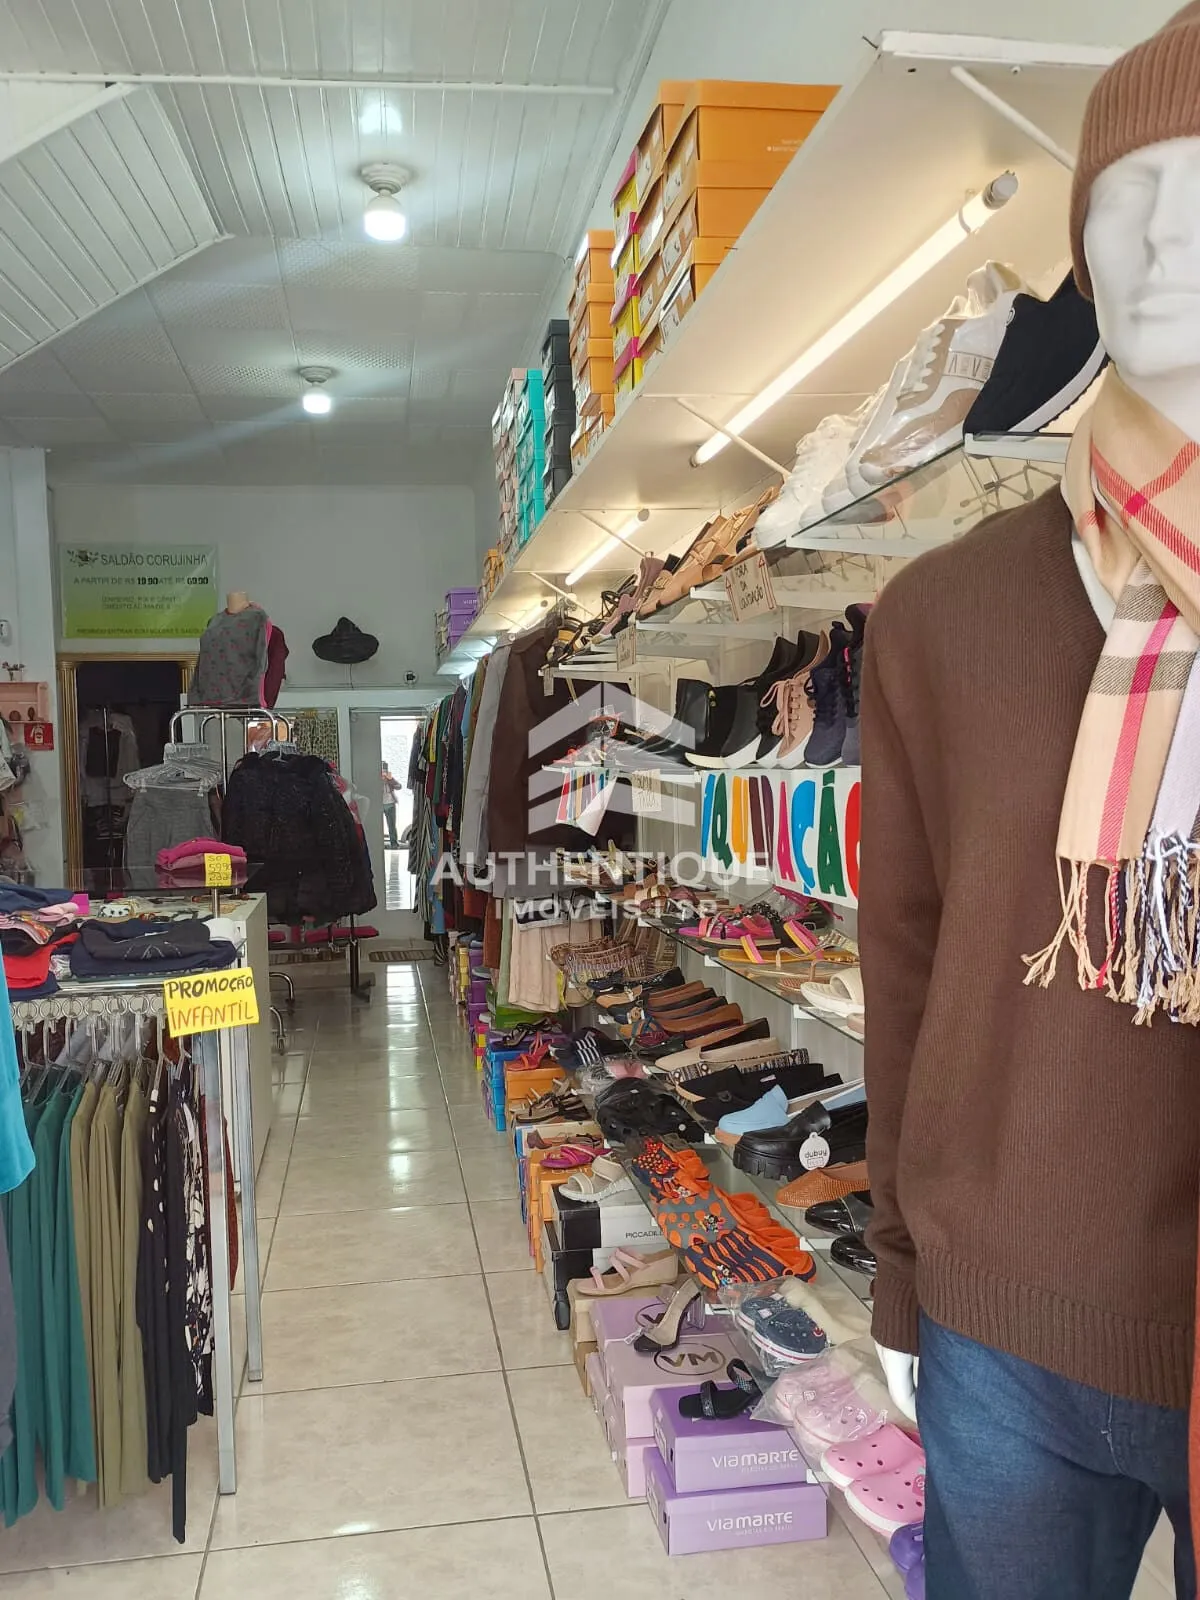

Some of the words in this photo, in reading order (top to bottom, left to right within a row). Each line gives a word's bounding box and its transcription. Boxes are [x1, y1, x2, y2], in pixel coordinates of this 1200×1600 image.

[101, 552, 144, 566] SALDÃO
[146, 553, 208, 566] CORUJINHA
[166, 975, 253, 1000] PROMOÇÃO
[170, 1000, 254, 1030] INFANTIL
[660, 1351, 719, 1367] VM
